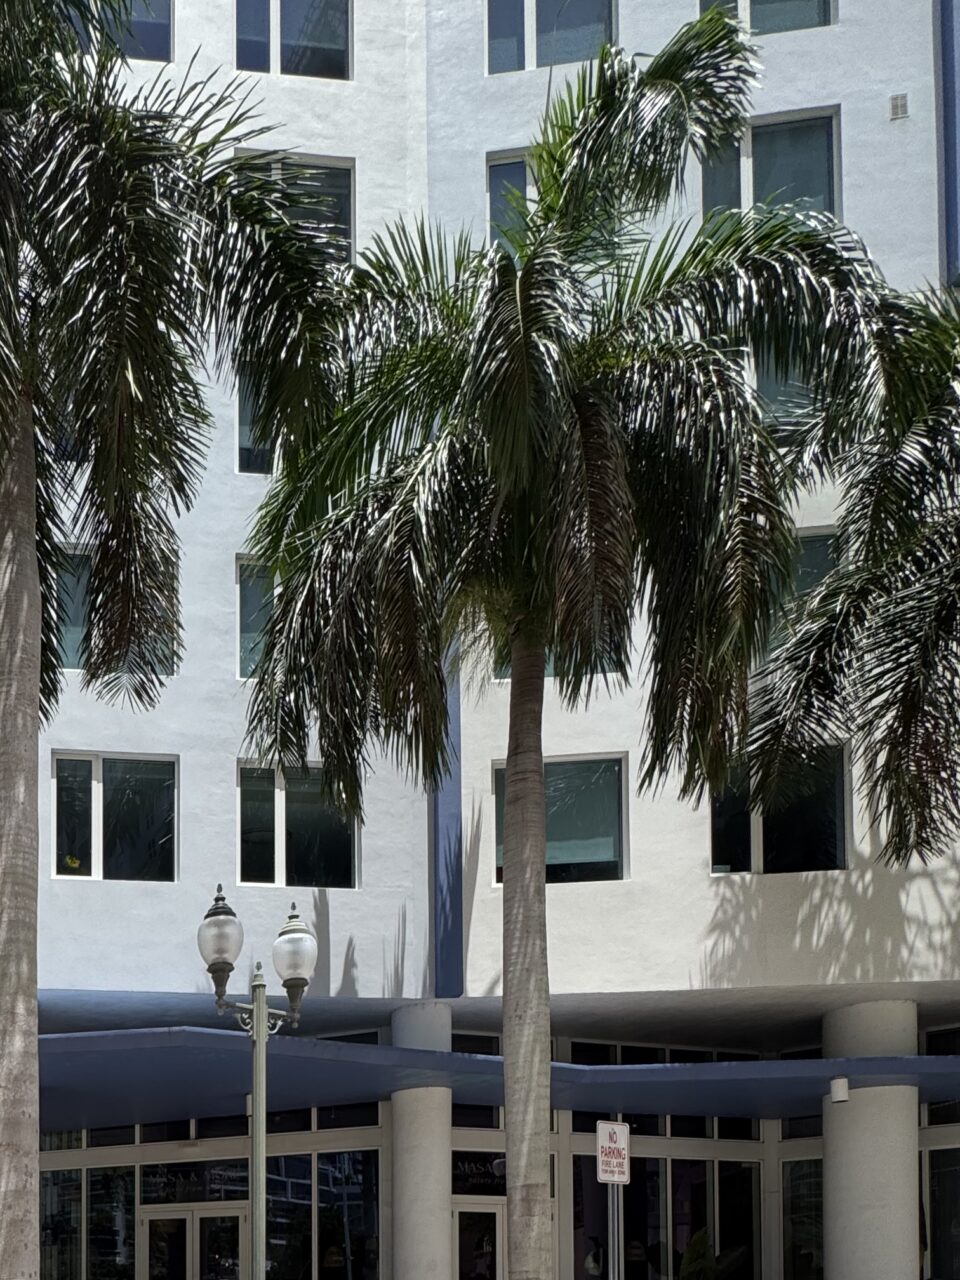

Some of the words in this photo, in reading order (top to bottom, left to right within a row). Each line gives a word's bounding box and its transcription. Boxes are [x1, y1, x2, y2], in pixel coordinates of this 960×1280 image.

[608, 1131, 617, 1144] NO
[601, 1145, 625, 1160] PARKING
[602, 1159, 611, 1168] FIRE
[613, 1161, 624, 1169] LANE
